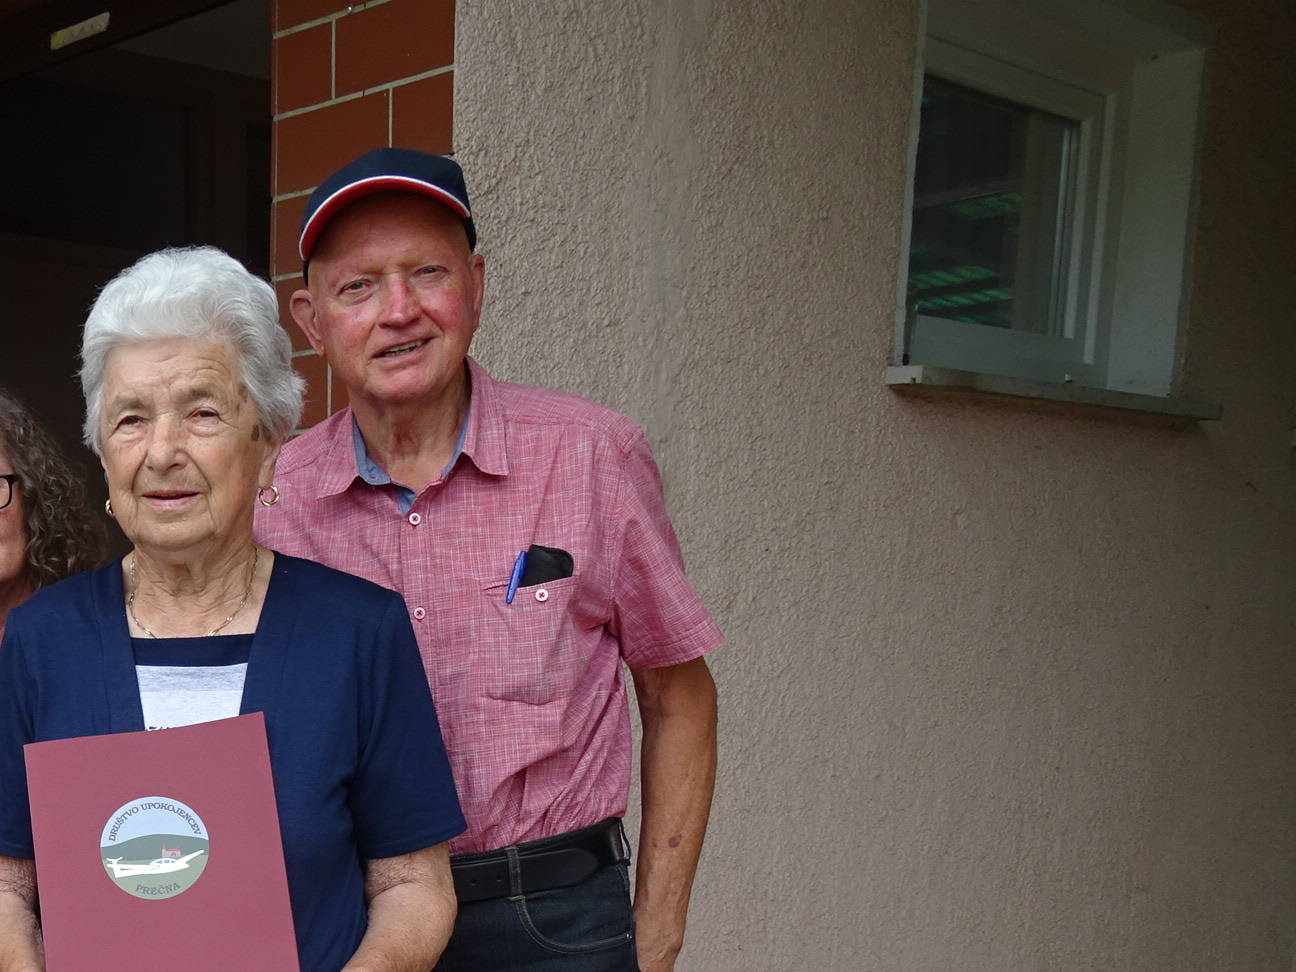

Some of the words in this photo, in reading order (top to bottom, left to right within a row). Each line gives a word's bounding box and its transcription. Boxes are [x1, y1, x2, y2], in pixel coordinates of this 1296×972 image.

[108, 806, 139, 842] DRUŠTVO
[141, 803, 201, 835] UPOKOJENCEV
[136, 882, 181, 895] PREČNA
